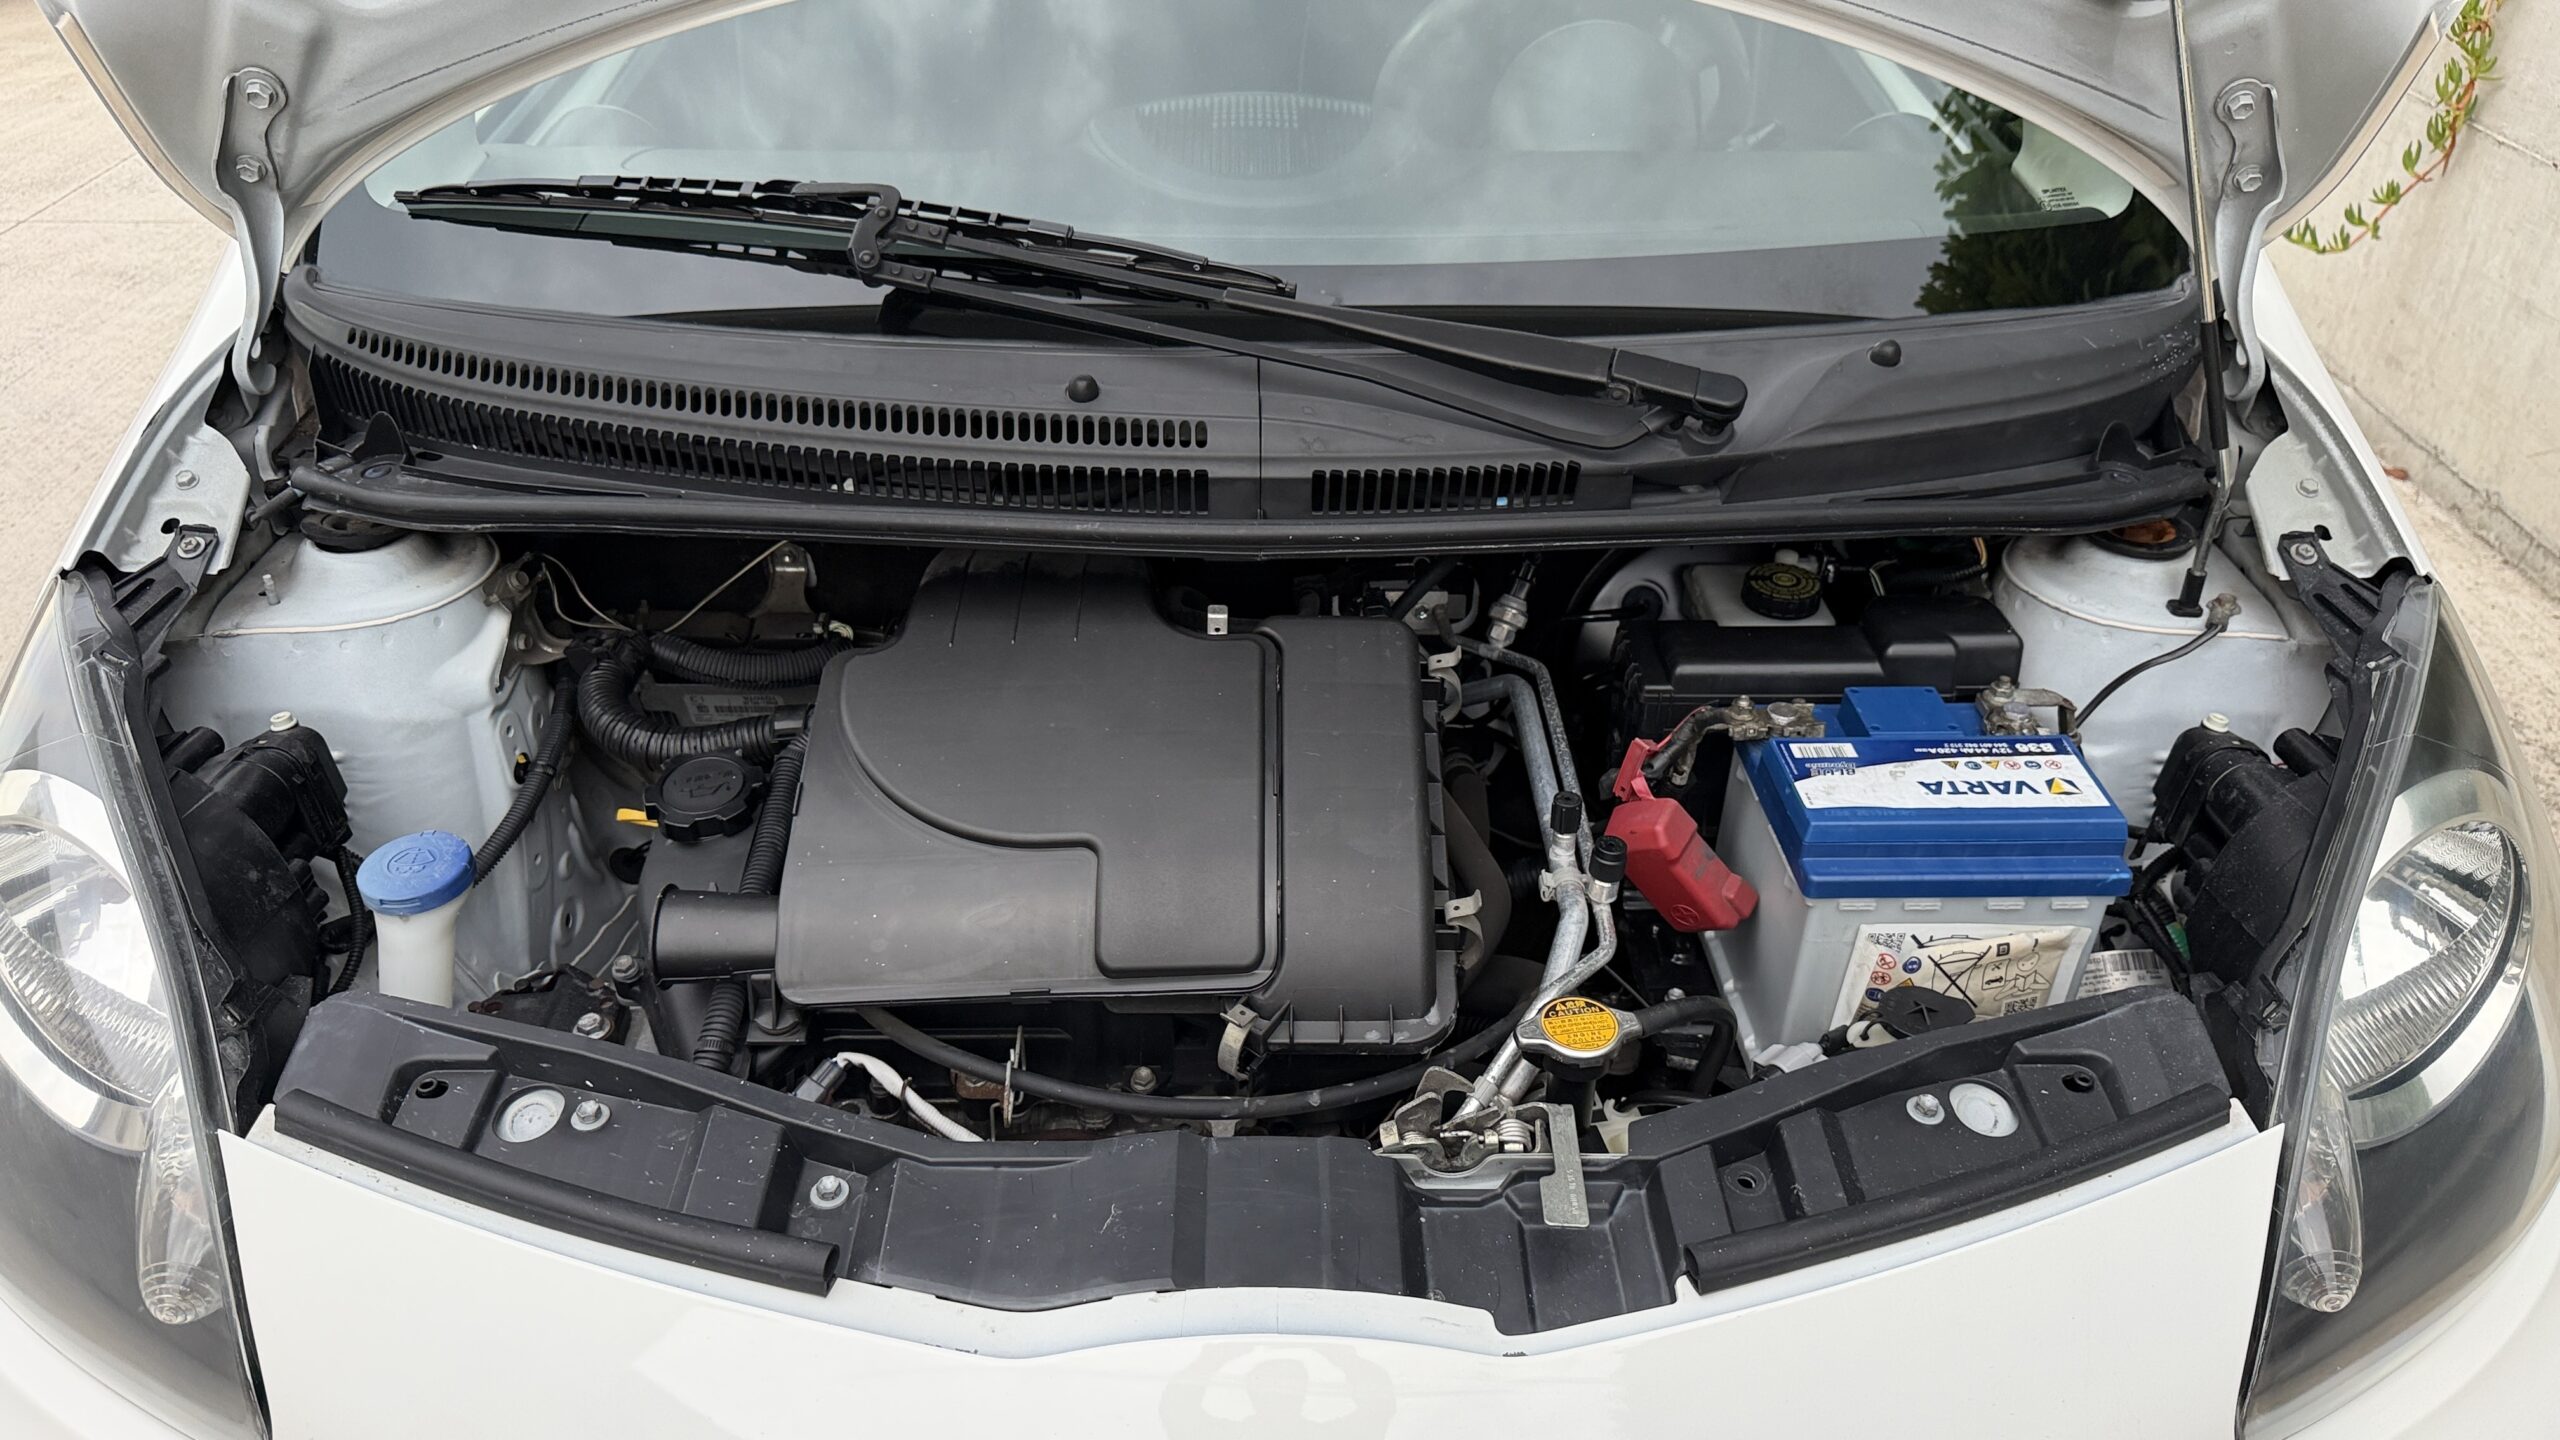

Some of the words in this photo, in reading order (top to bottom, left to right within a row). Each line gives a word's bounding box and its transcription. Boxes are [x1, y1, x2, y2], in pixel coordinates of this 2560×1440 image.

[1810, 768, 1856, 776] BLUE
[1917, 780, 2041, 795] VARTA
[1549, 1006, 1600, 1017] CAUTION
[1567, 1035, 1606, 1043] COOLANT
